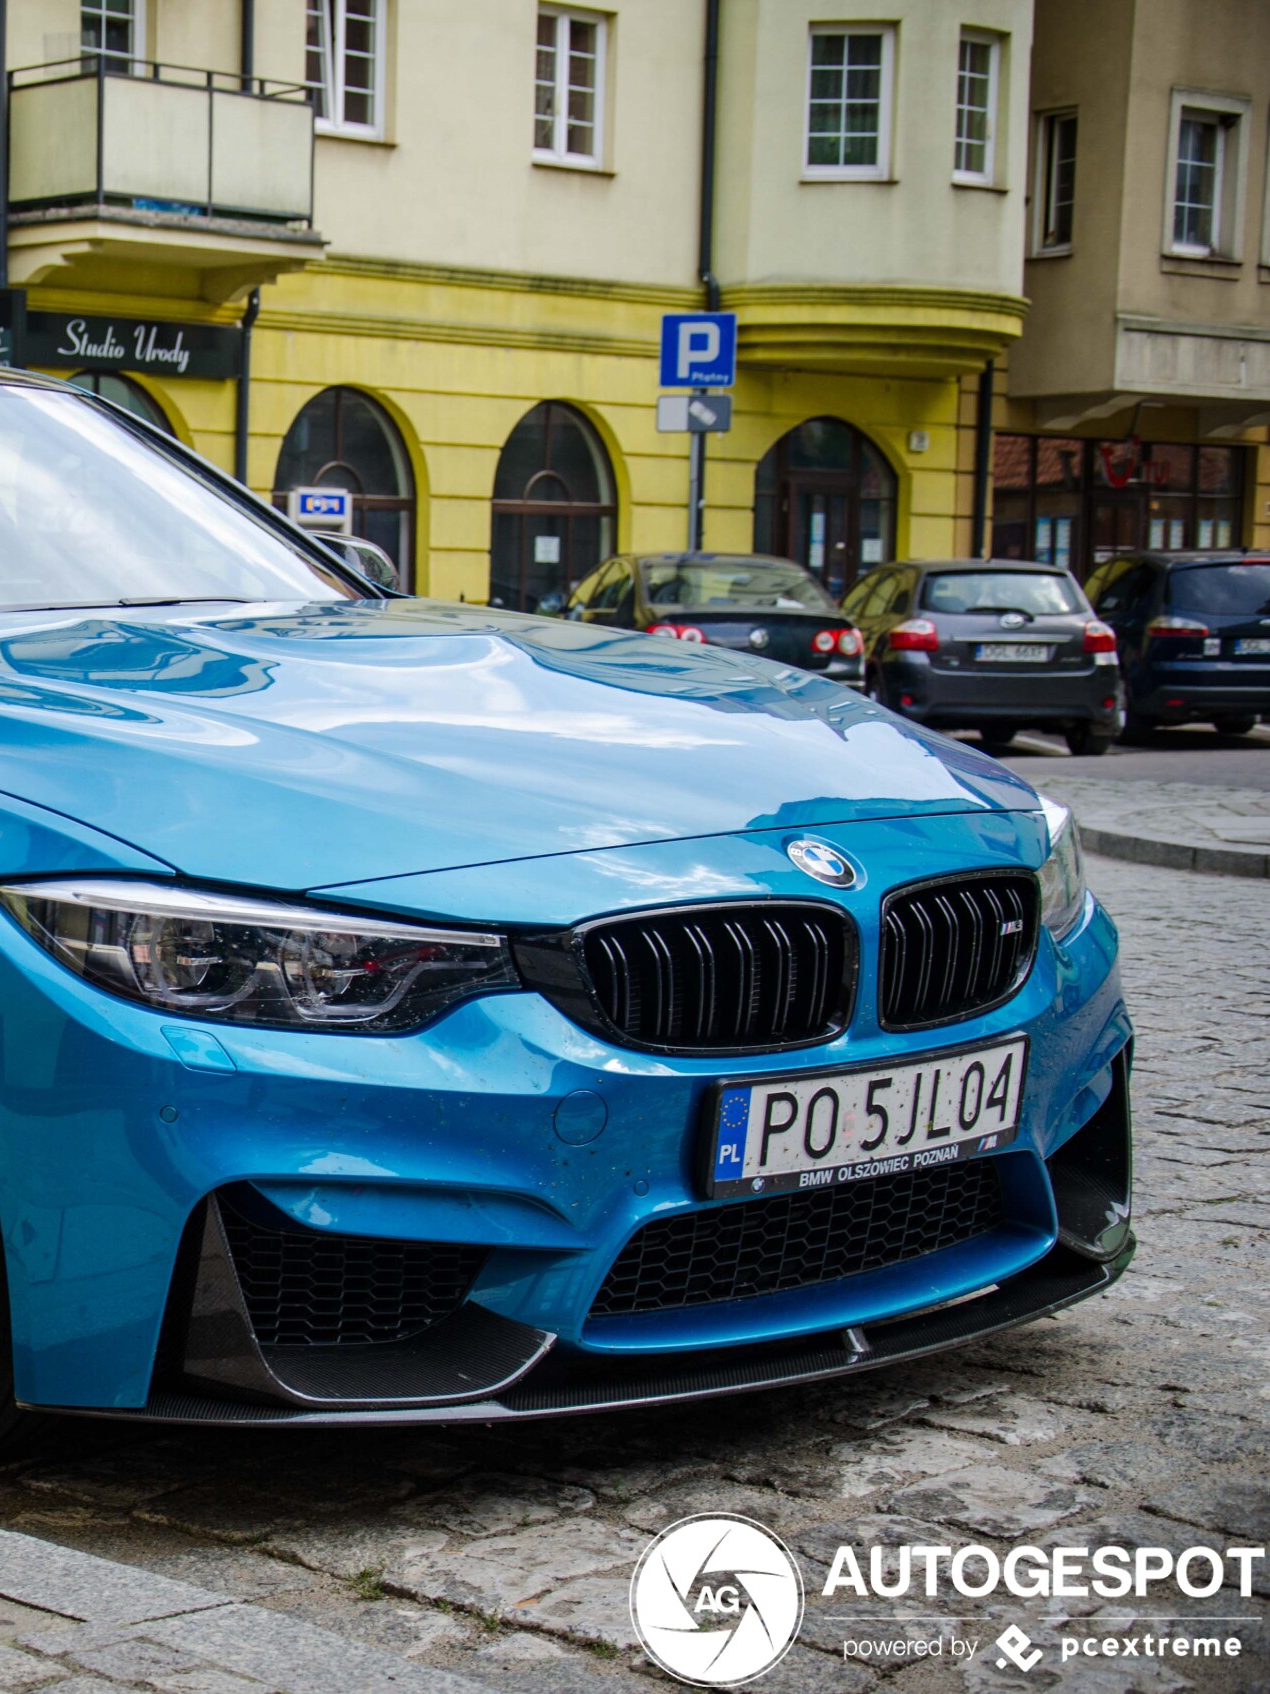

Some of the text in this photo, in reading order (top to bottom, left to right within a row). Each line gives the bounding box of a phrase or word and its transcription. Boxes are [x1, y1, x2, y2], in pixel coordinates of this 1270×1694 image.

[57, 319, 190, 373] Studio Urody
[676, 322, 720, 378] P
[759, 1052, 1013, 1167] PO 5JL04
[719, 1144, 741, 1165] PL
[799, 1144, 959, 1187] BMW OLSZOWIEC POZNAŃ
